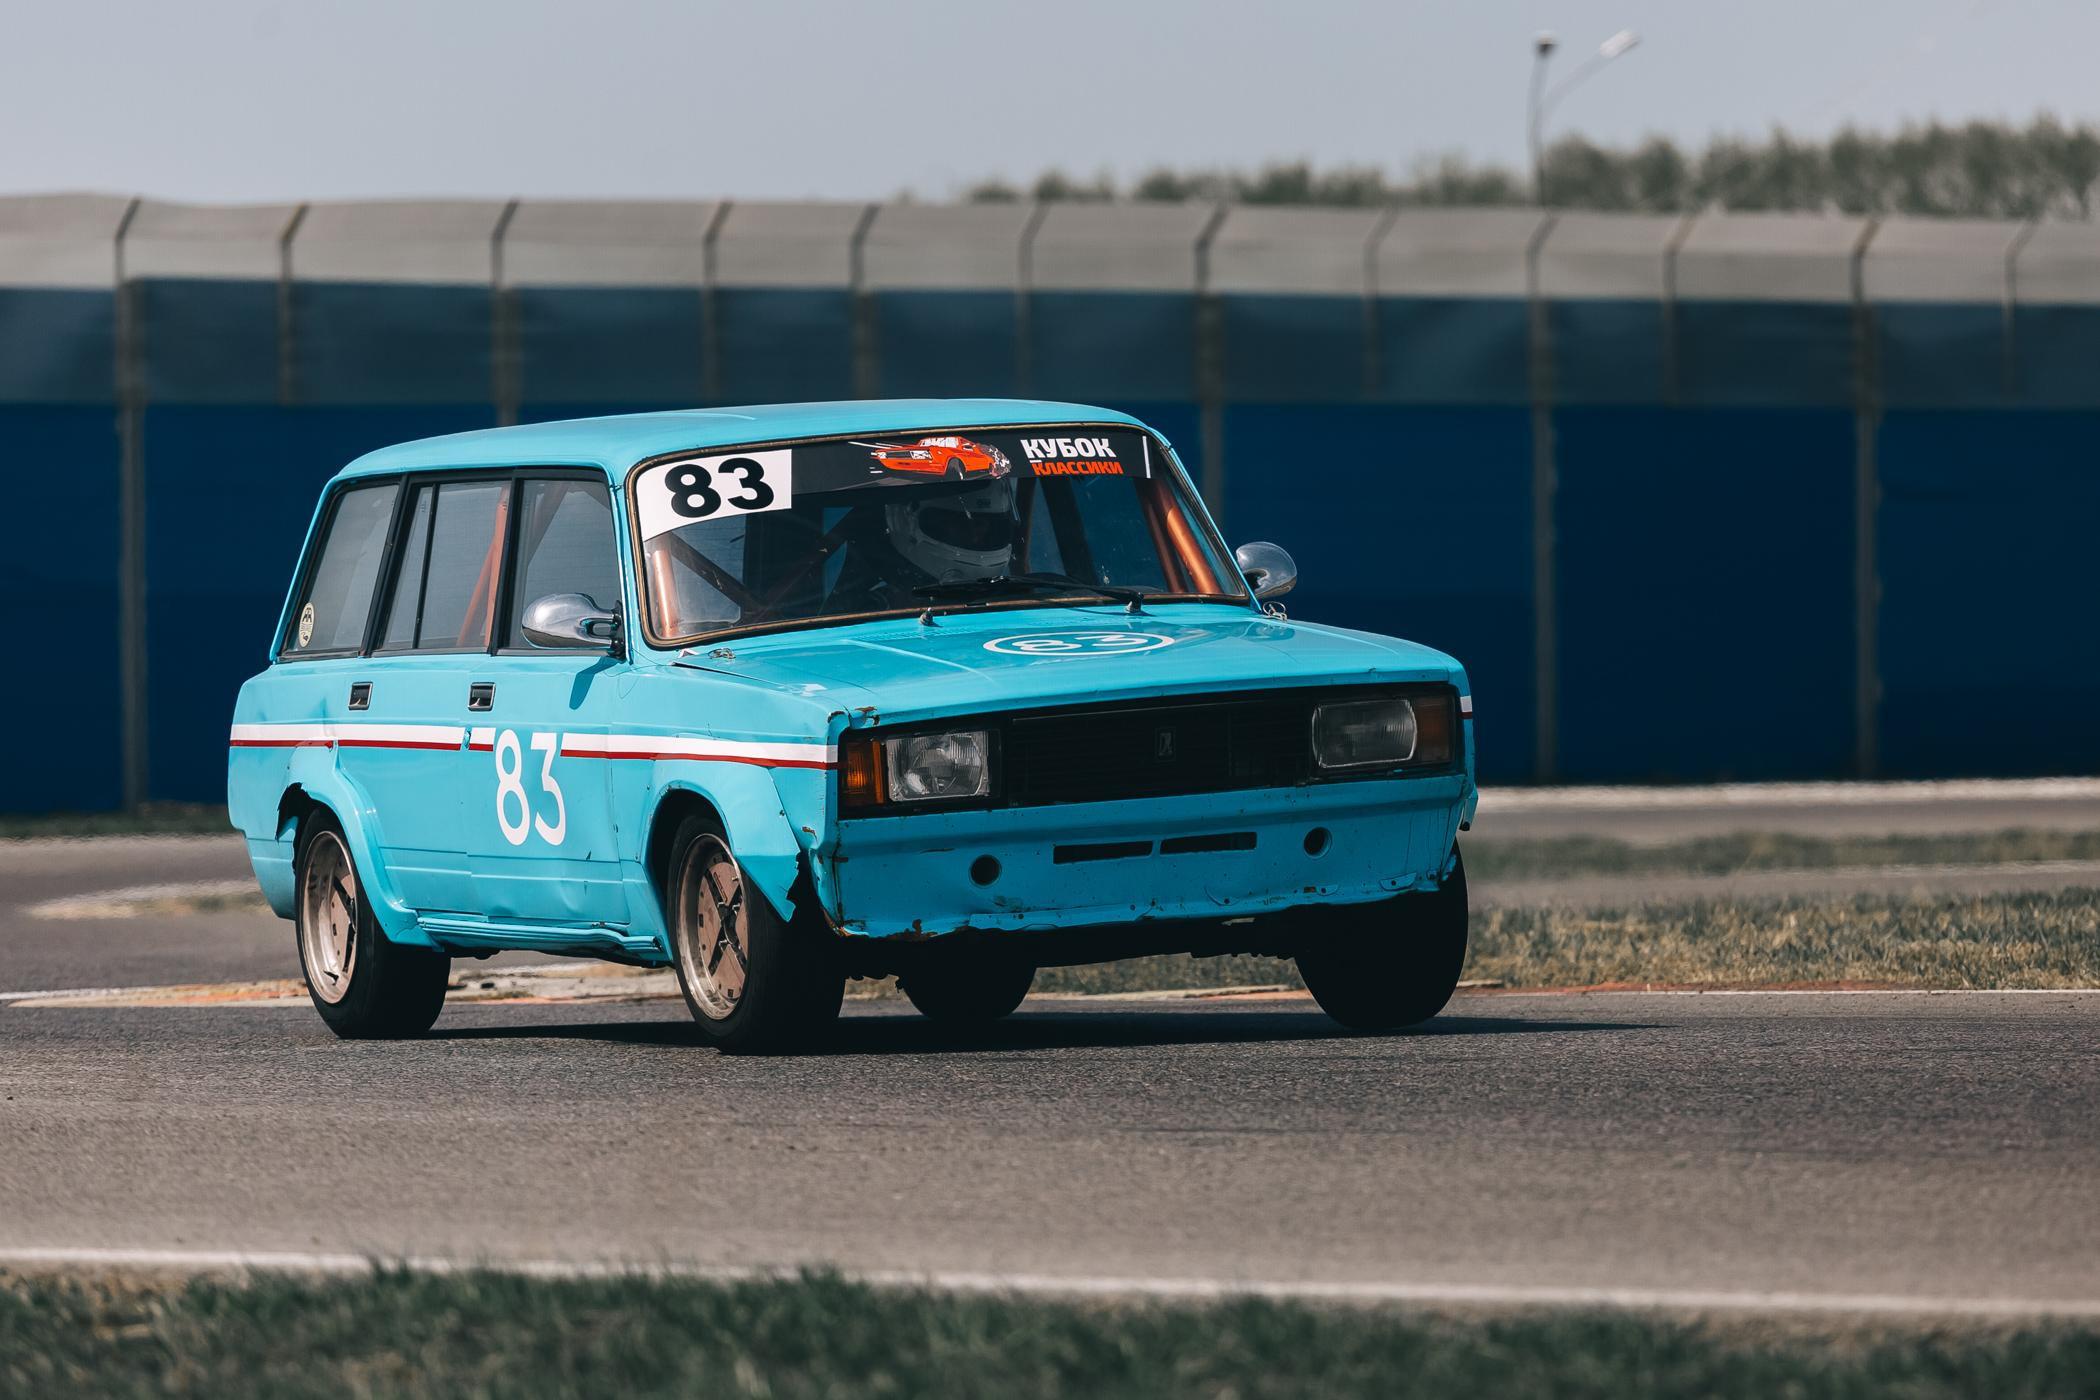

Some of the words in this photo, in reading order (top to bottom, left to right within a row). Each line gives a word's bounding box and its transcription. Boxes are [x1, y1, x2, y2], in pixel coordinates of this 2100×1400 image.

[1020, 438, 1117, 459] КУБОК
[1031, 461, 1124, 476] КЛАССИКИ
[664, 457, 774, 518] 83
[1012, 635, 1148, 651] 83
[495, 729, 566, 846] 83
